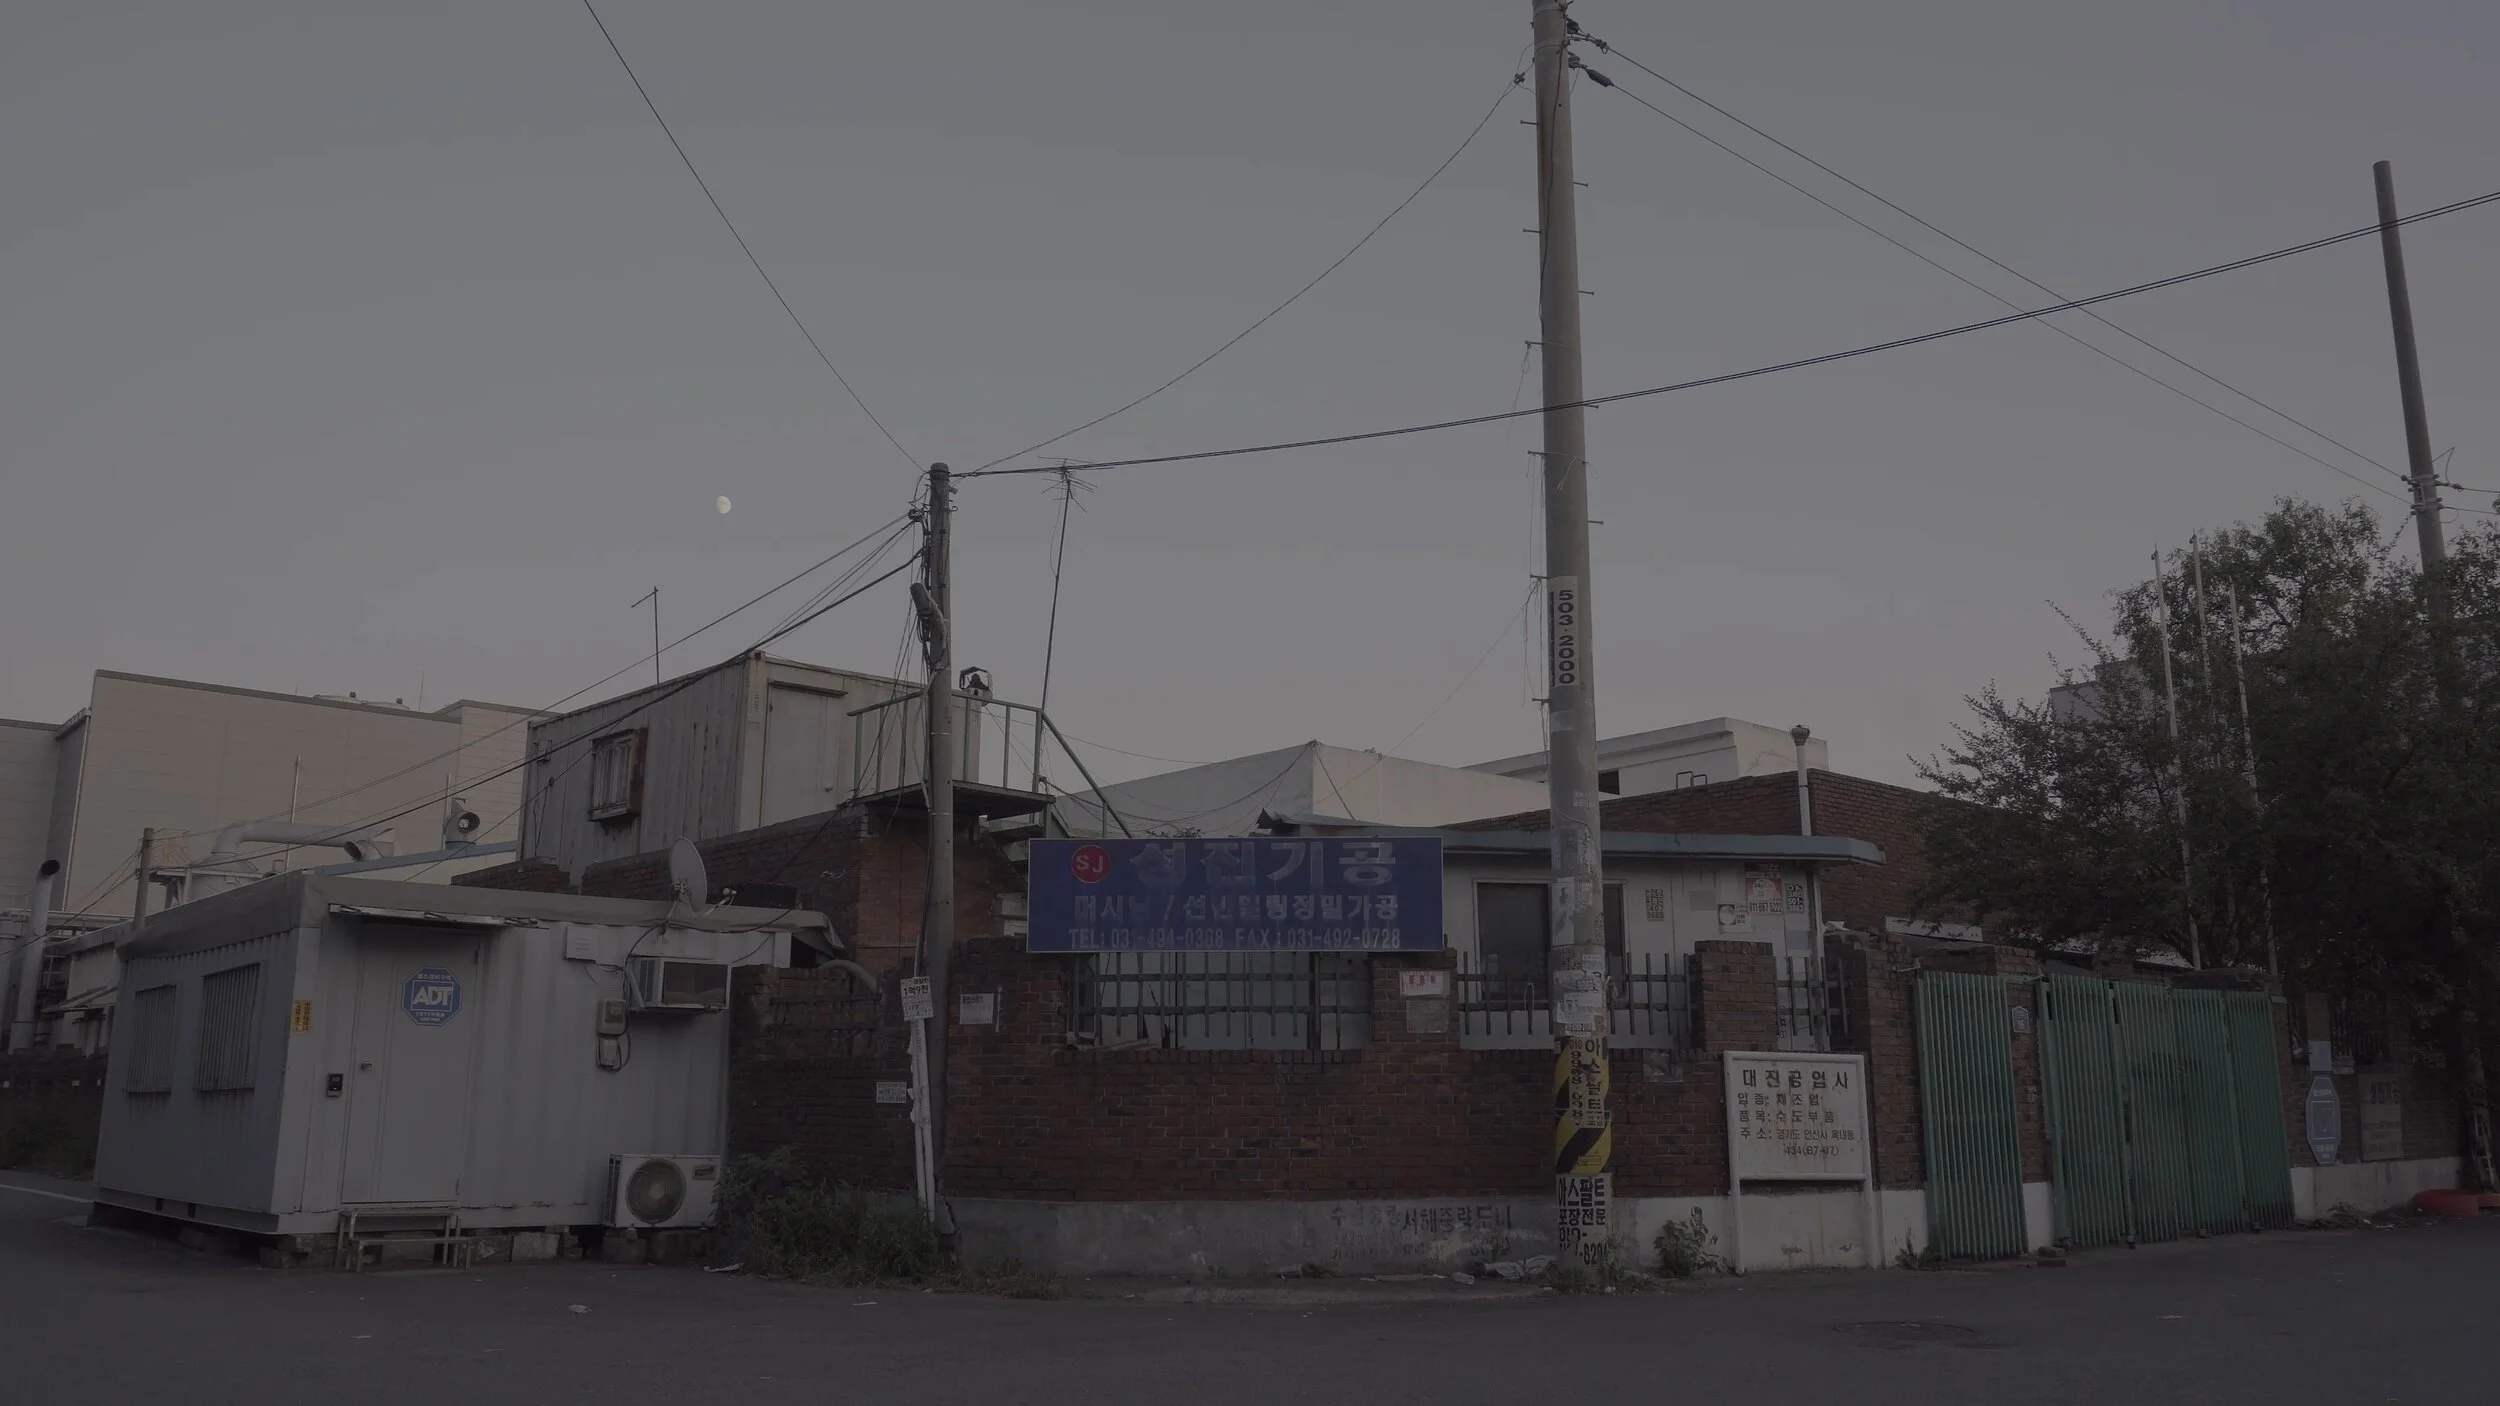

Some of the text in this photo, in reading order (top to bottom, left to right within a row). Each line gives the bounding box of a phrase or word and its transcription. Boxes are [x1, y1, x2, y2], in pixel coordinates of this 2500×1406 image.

[1075, 854, 1104, 873] SJ
[1069, 928, 1105, 950] TEL:
[412, 986, 453, 1006] ADT
[1559, 1177, 1606, 1207] 아스팔트
[1559, 1208, 1606, 1226] 포장전문
